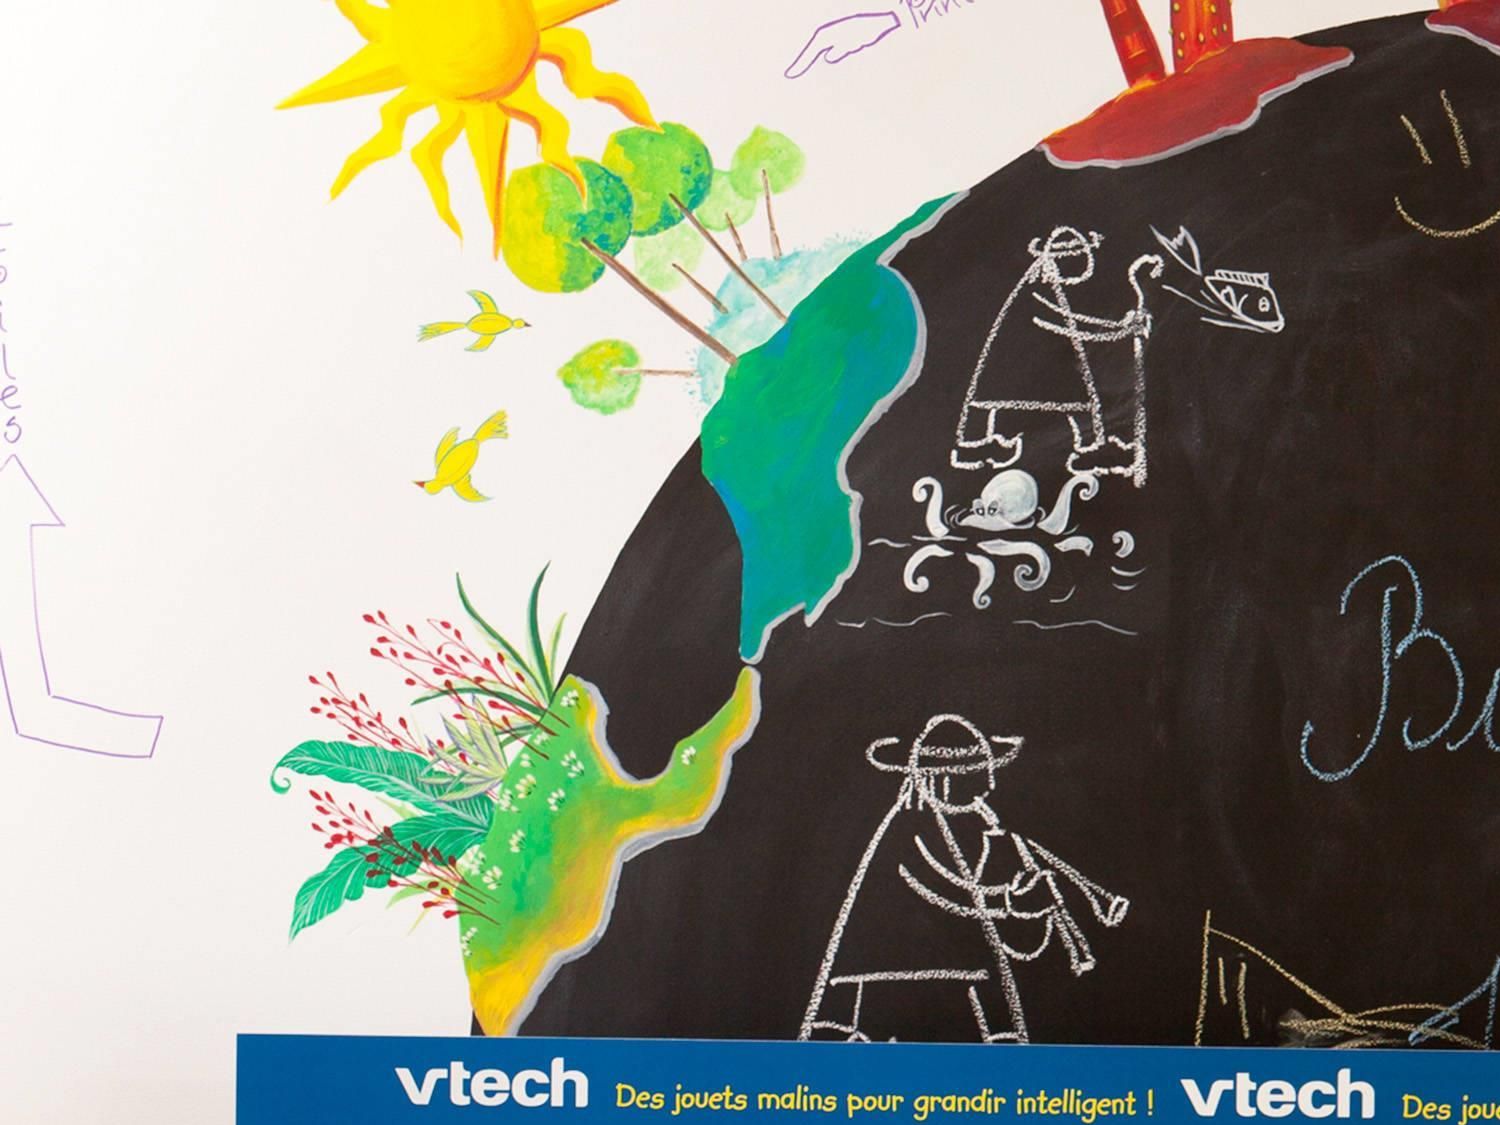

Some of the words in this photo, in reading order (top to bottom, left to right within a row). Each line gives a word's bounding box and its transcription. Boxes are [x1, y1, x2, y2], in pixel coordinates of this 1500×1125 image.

[395, 1056, 589, 1108] vtech
[616, 1082, 665, 1110] Des
[671, 1083, 748, 1116] jouets
[757, 1084, 838, 1112] malins
[846, 1092, 904, 1119] pour
[912, 1088, 1007, 1121] grandir
[1016, 1088, 1137, 1124] intelligent
[1147, 1089, 1155, 1116] !
[1180, 1067, 1376, 1119] vtech
[1401, 1094, 1452, 1121] Des
